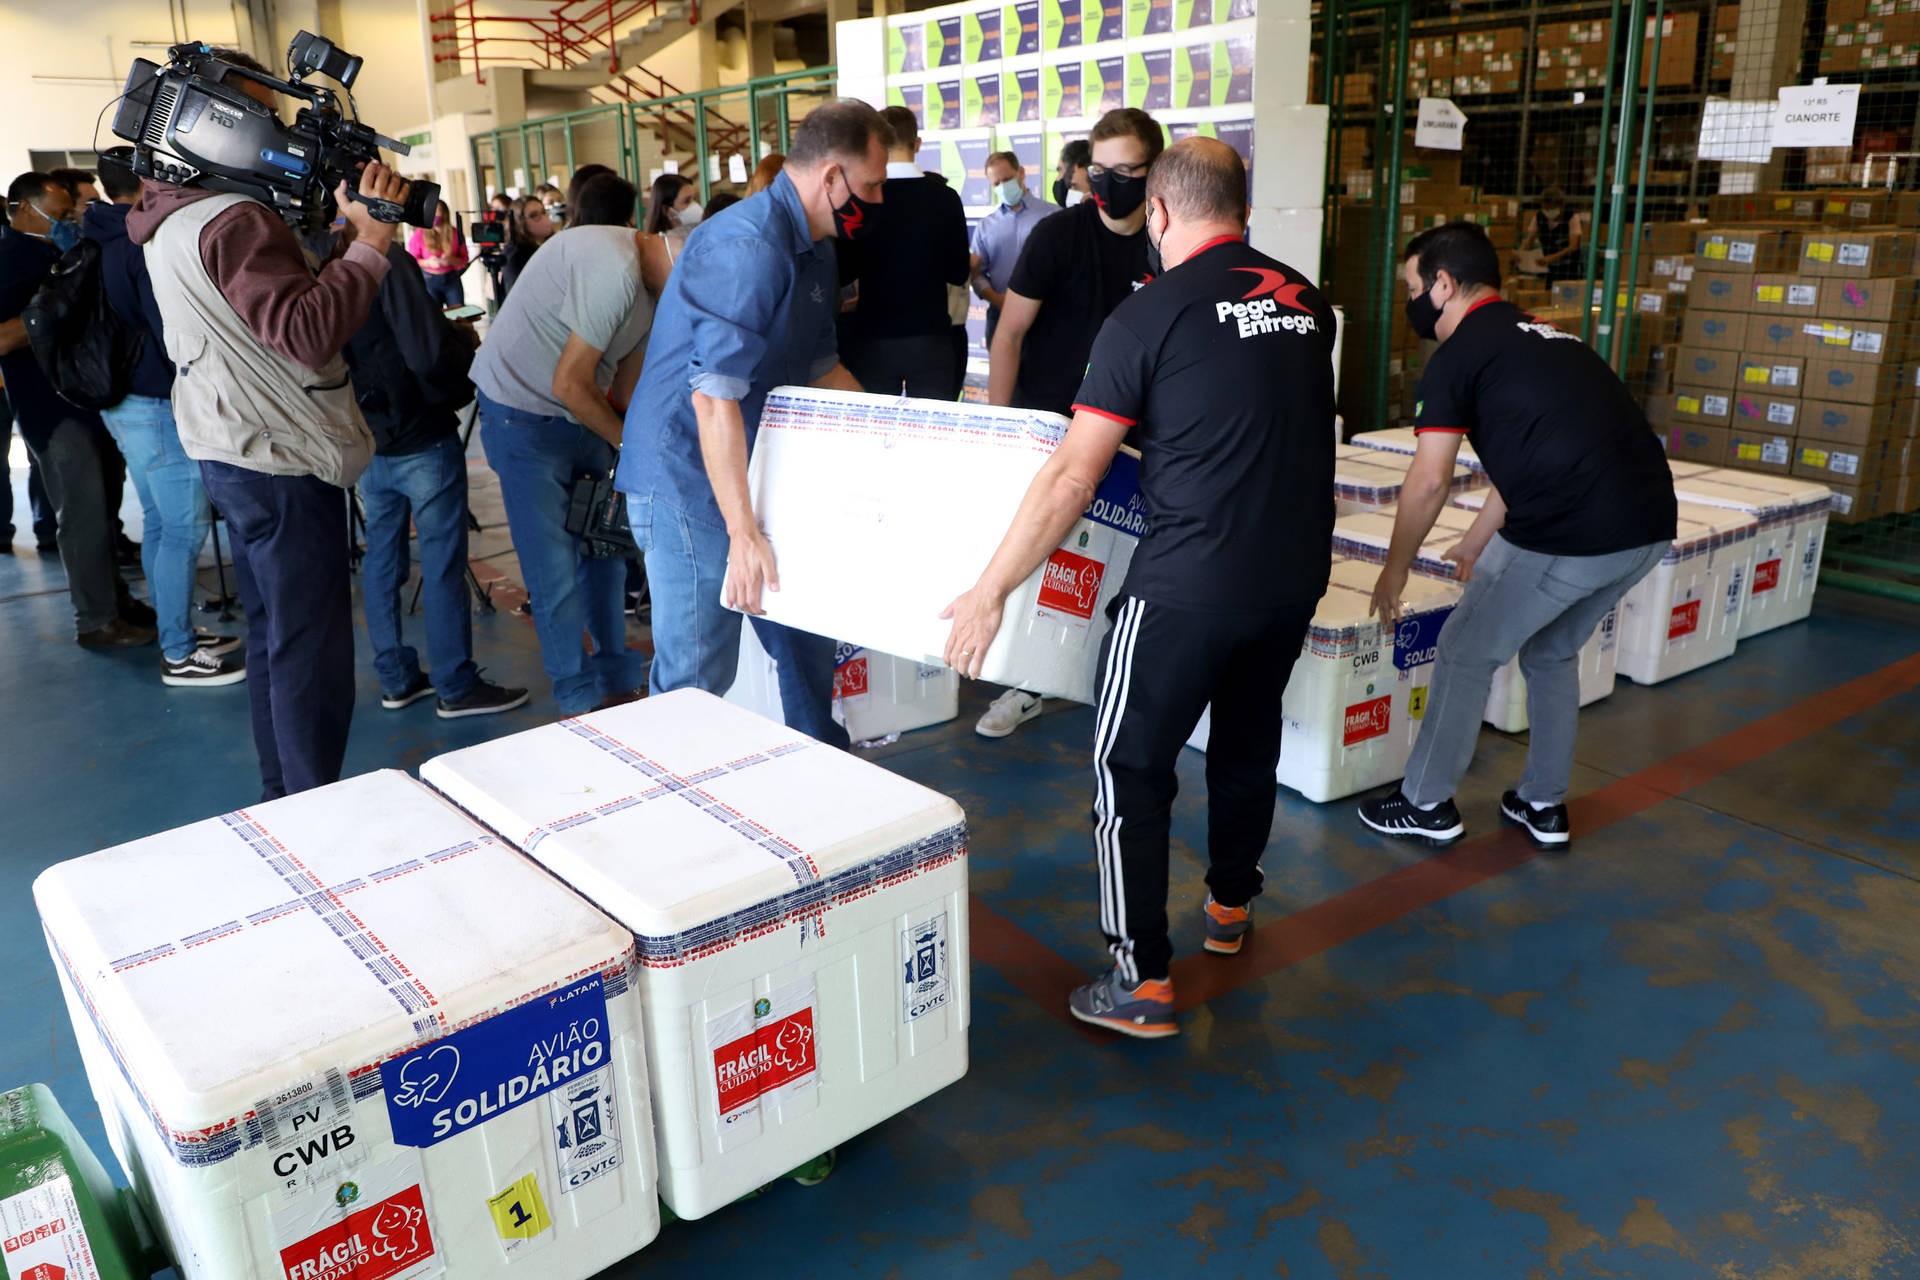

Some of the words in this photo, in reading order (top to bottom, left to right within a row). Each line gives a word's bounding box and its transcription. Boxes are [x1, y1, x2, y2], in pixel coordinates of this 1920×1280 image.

[1785, 112, 1841, 123] CIANORTE
[1215, 298, 1277, 323] Pega
[1237, 314, 1316, 339] Entrega
[1046, 561, 1077, 585] FRÁGIL
[1353, 651, 1379, 668] CWB
[1413, 697, 1421, 711] 1
[743, 923, 786, 942] FRAGIL
[560, 980, 599, 1003] LATAM
[528, 1018, 599, 1067] AVIÃO
[717, 1043, 772, 1083] FRÁGIL
[432, 1041, 603, 1138] SOLIDÁRIO
[720, 1060, 773, 1094] CUIDADO
[276, 1082, 313, 1105] 2613800
[292, 1106, 320, 1132] PV
[273, 1125, 356, 1177] CWB
[287, 1179, 297, 1188] R
[509, 1201, 532, 1228] 1
[289, 1233, 369, 1280] FRÁGIL
